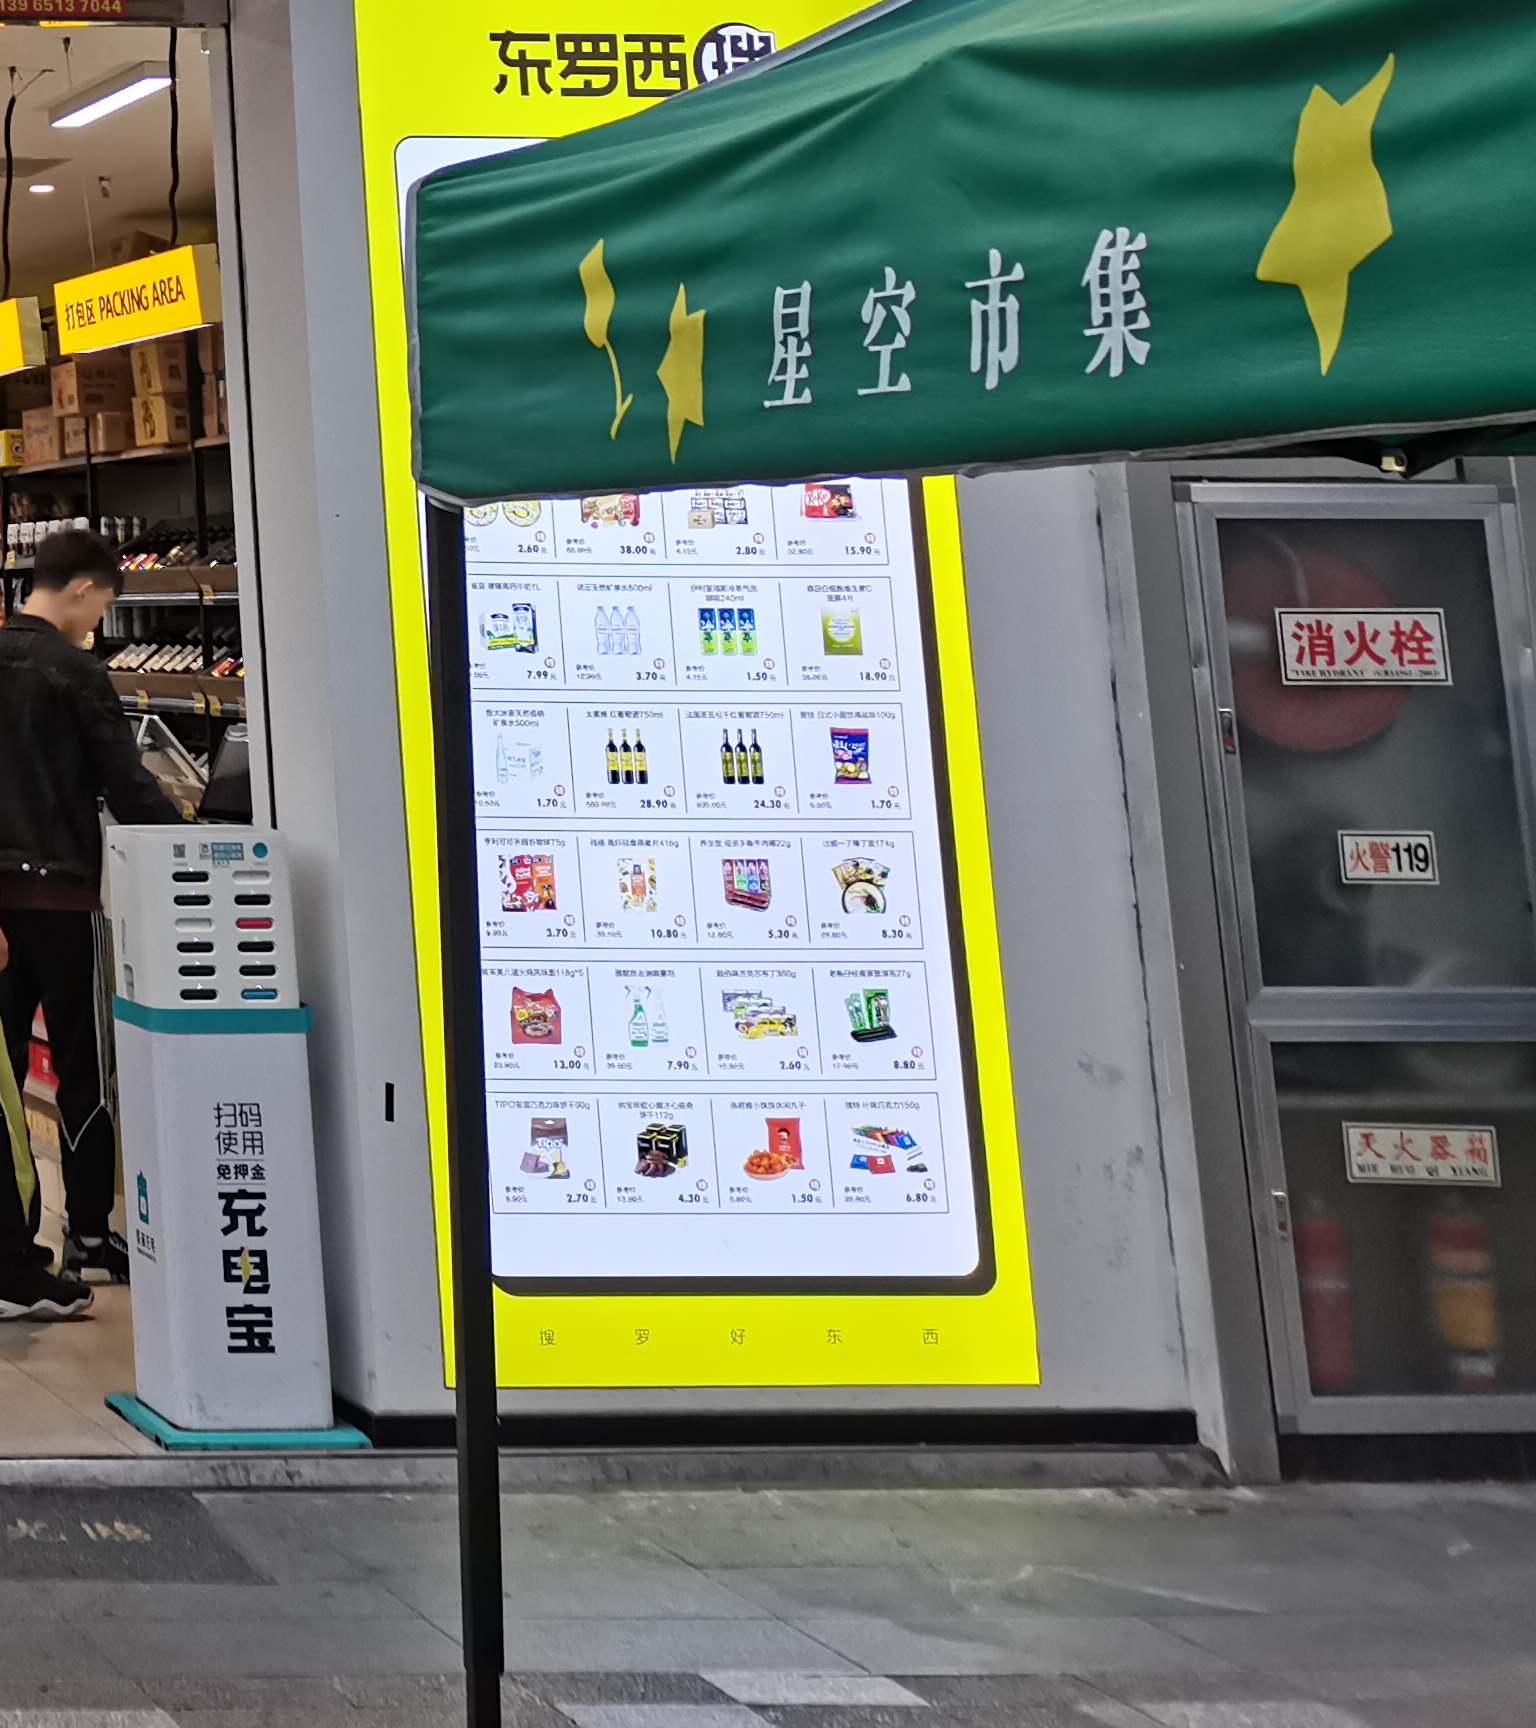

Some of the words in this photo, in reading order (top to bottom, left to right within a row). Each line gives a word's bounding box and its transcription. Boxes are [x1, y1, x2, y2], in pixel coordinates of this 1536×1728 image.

[81, 0, 122, 13] 7044
[65, 299, 96, 331] 打包区
[99, 285, 148, 320] PACKING
[152, 275, 185, 305] AREA
[762, 226, 1152, 409] 星空市集
[1291, 620, 1436, 667] 消火栓
[213, 1103, 262, 1127] 扫码
[215, 1131, 264, 1155] 使用
[217, 1164, 266, 1180] 免押金
[218, 1189, 275, 1354] 充电宝
